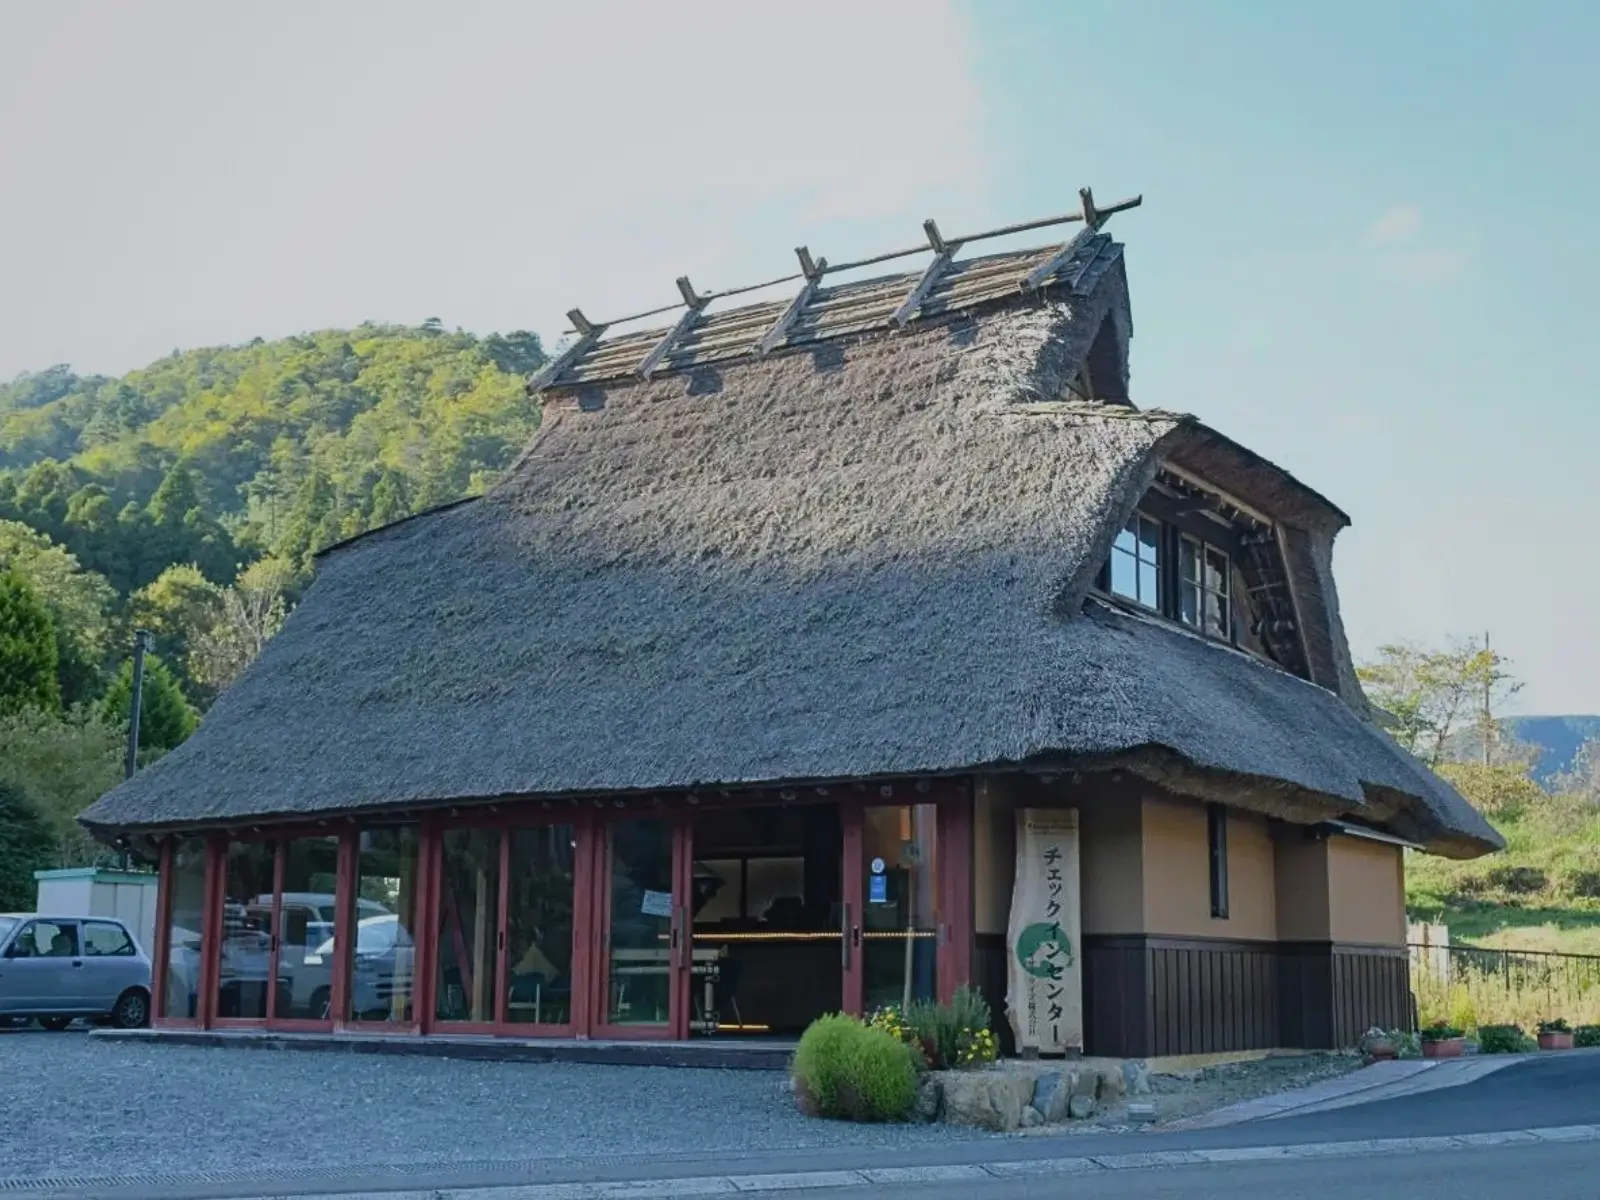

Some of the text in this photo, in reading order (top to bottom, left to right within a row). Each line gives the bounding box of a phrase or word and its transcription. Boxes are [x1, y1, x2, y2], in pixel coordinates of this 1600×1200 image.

[1043, 846, 1064, 1042] チェックインセンター
